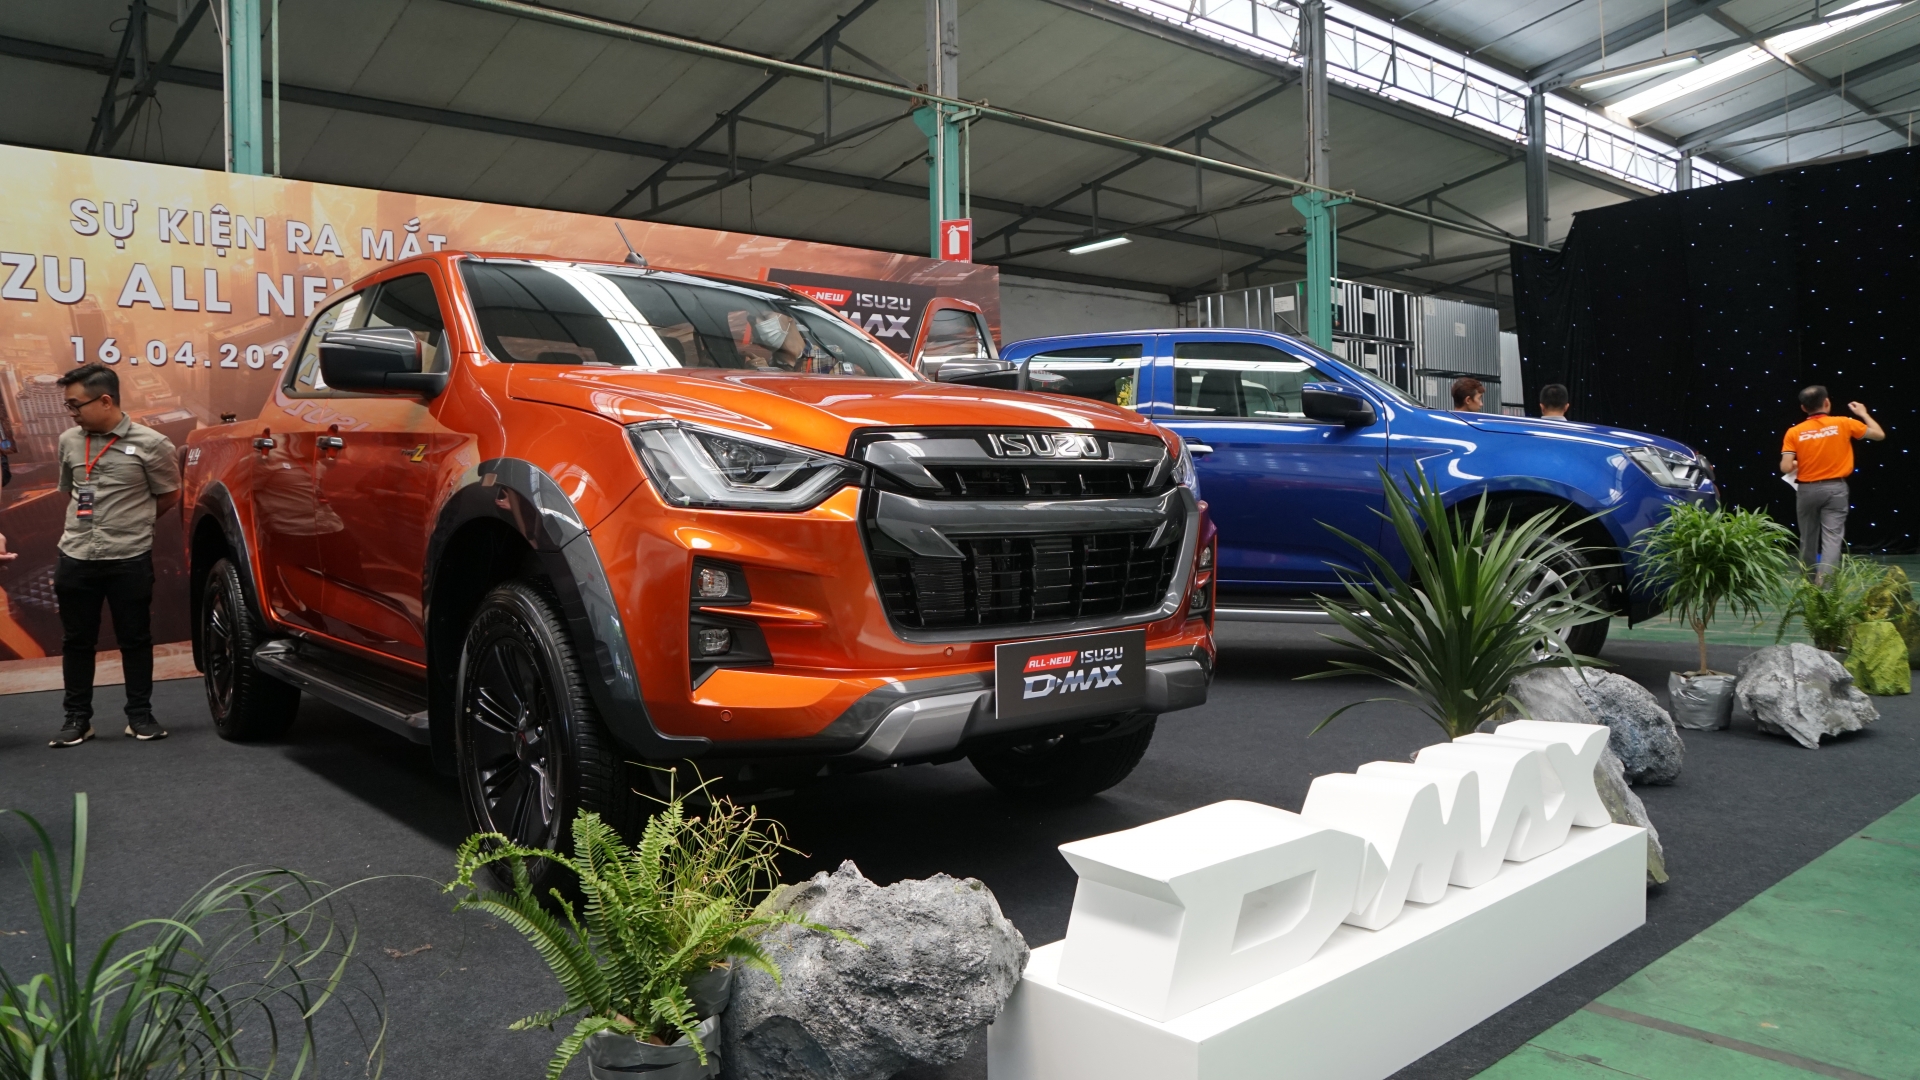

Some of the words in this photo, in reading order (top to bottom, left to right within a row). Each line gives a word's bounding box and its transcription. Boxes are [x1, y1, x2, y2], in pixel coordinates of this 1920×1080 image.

[70, 198, 138, 249] SỰ
[158, 203, 266, 257] KIỆN
[286, 220, 344, 257] RA
[361, 217, 447, 261] MẮT
[117, 263, 232, 314] ALL
[257, 272, 345, 317] NE
[856, 293, 911, 311] ISUZU
[987, 433, 1102, 457] ISUZU
[1028, 655, 1072, 669] ALL-NEW
[1080, 646, 1124, 664] ISUZU
